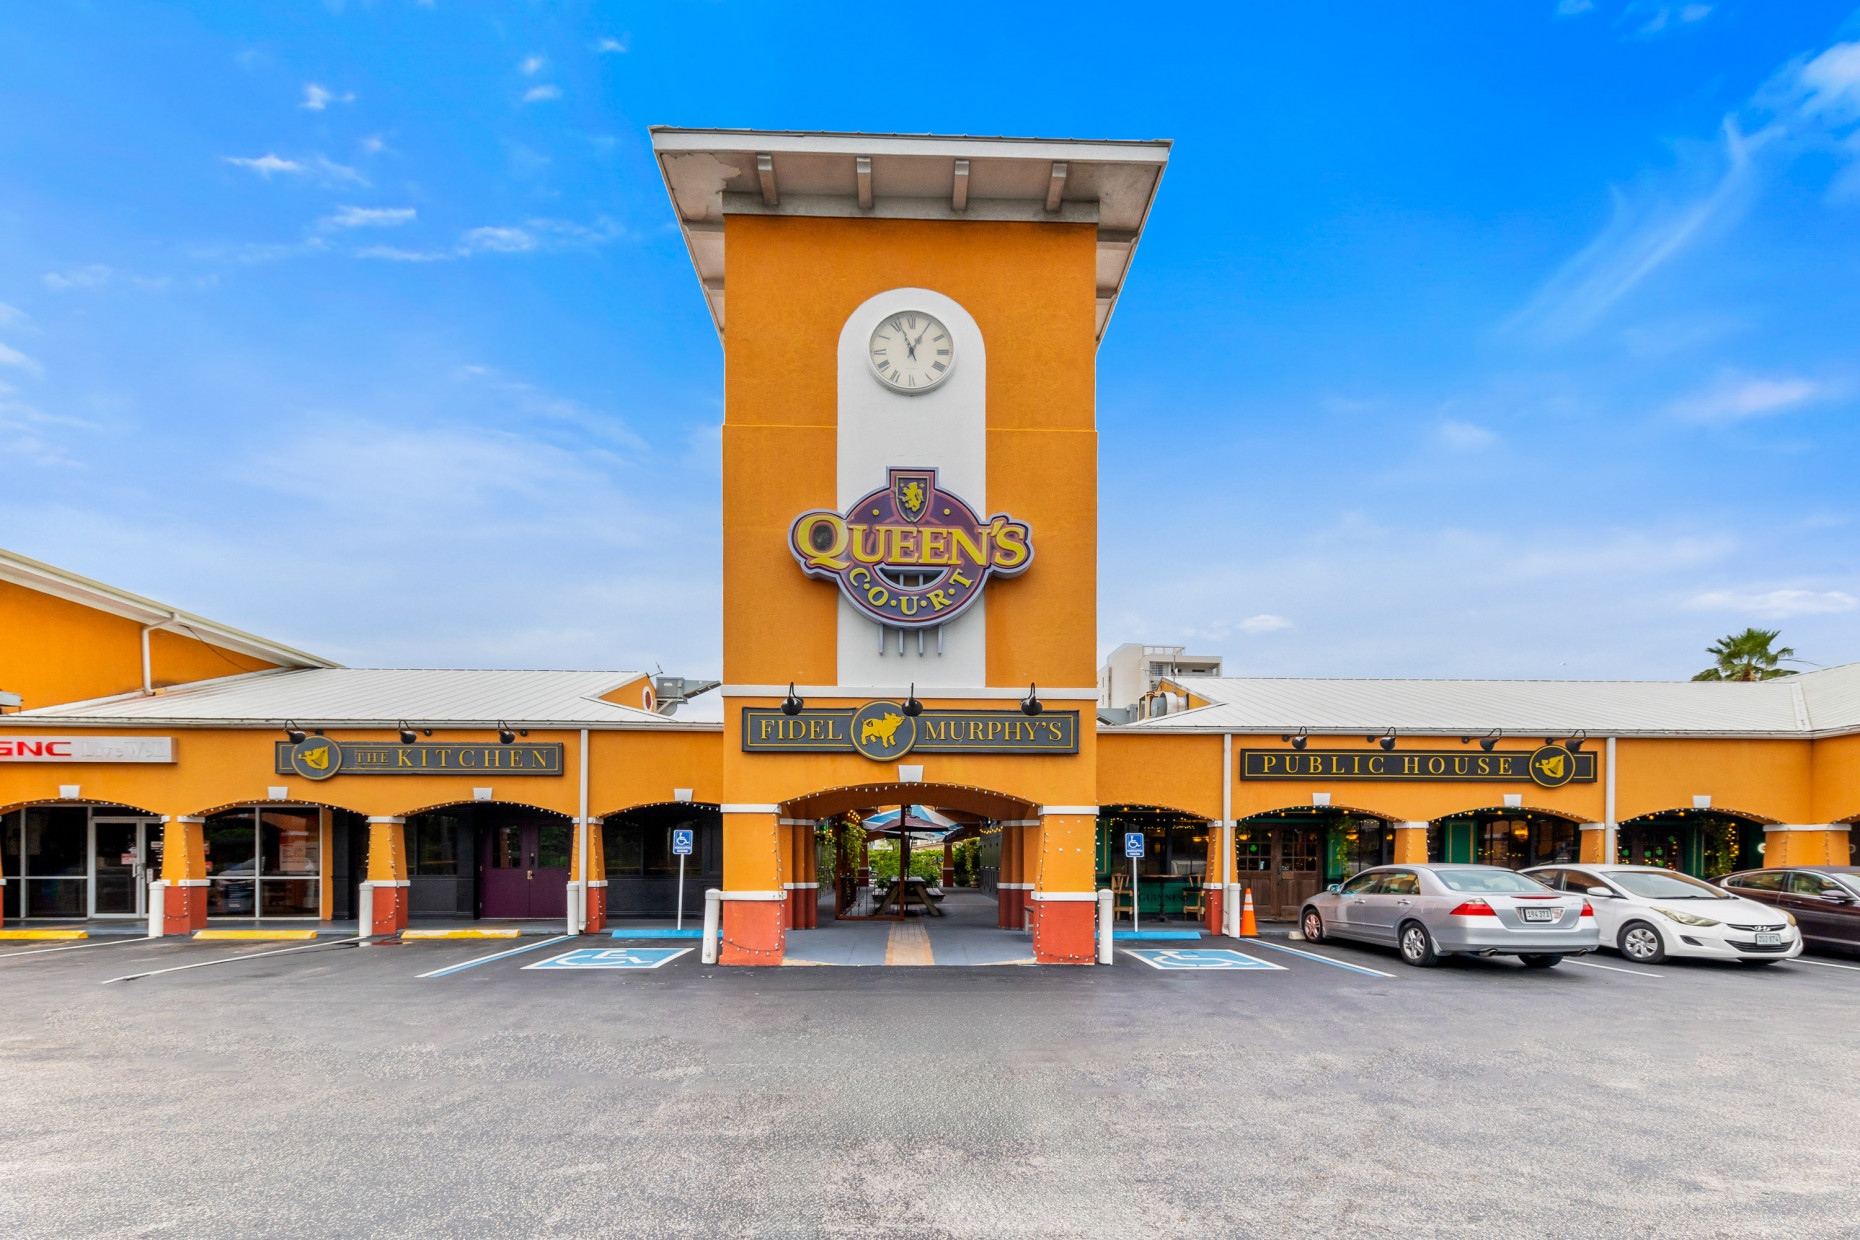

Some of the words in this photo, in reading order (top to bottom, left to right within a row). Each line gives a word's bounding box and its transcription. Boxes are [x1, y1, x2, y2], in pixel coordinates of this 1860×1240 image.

[797, 515, 1026, 570] QUEEN'S
[759, 719, 843, 741] FIDEL
[924, 720, 1063, 742] MURPHY'S
[356, 753, 389, 764] THE
[397, 749, 548, 768] KITCHEN
[1262, 755, 1385, 774] PUBLIC
[1403, 757, 1513, 776] HOUSE
